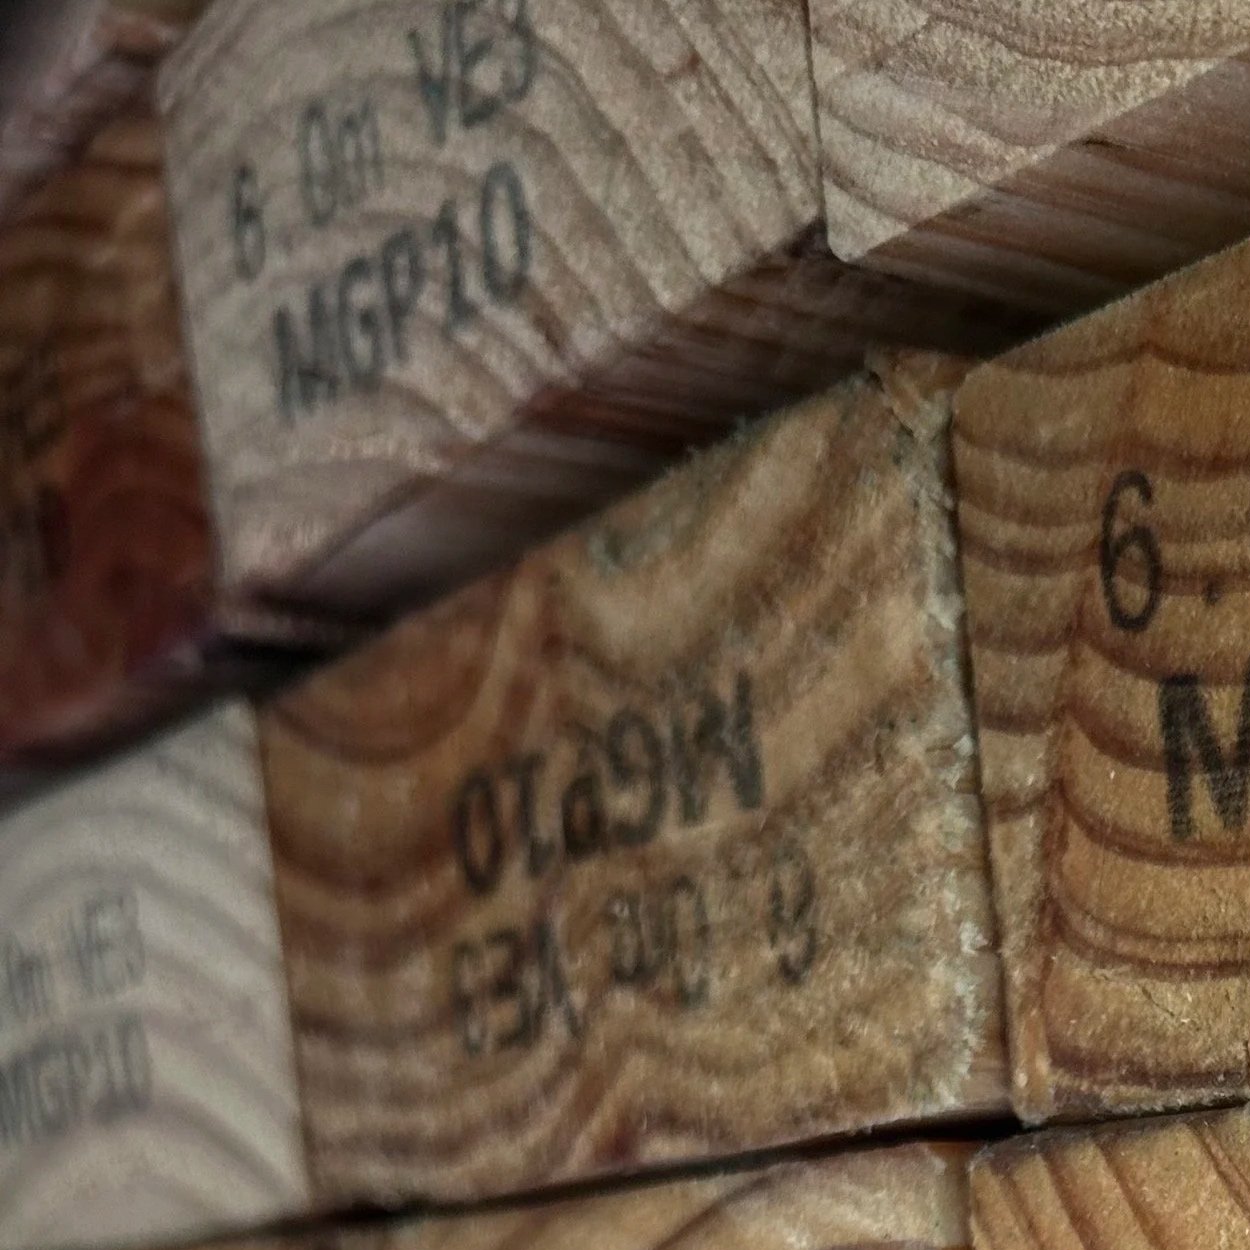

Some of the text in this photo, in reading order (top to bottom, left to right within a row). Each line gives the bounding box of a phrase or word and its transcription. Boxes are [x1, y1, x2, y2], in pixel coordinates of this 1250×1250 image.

[405, 0, 540, 150] VE3
[273, 157, 532, 425] MGP10
[453, 666, 767, 900] MGP10
